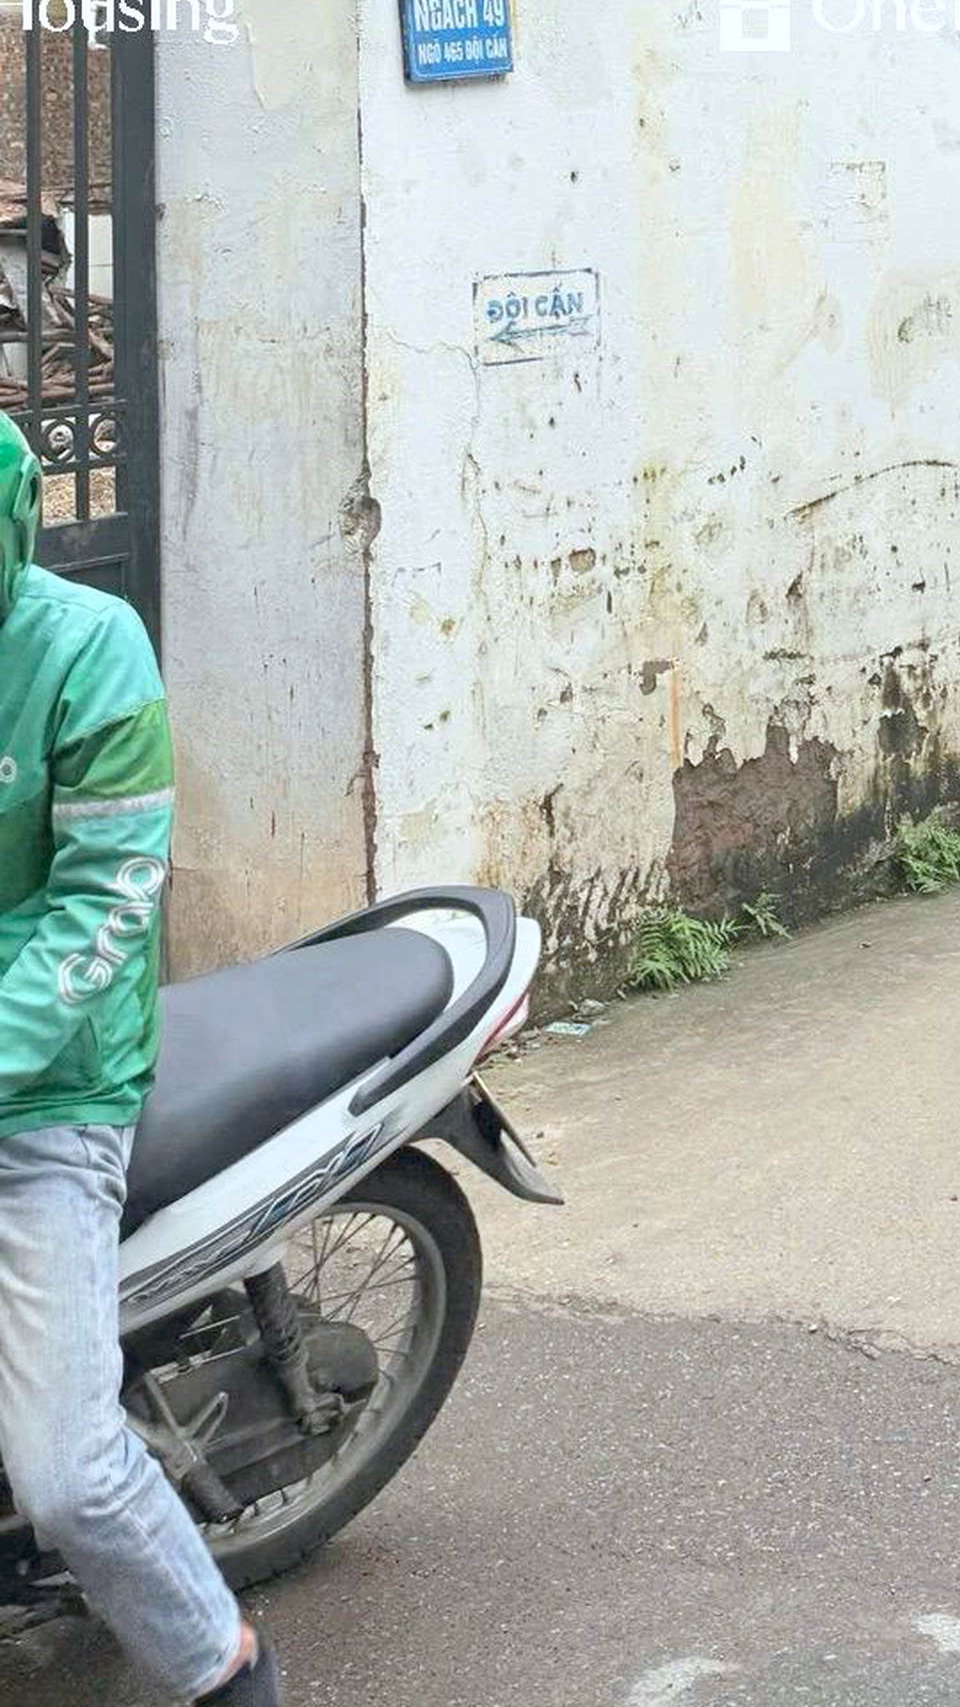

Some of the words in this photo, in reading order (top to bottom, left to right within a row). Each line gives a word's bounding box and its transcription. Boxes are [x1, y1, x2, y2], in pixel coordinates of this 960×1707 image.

[418, 37, 441, 64] NGÕ
[444, 41, 464, 62] 465
[57, 855, 165, 1005] Grab
